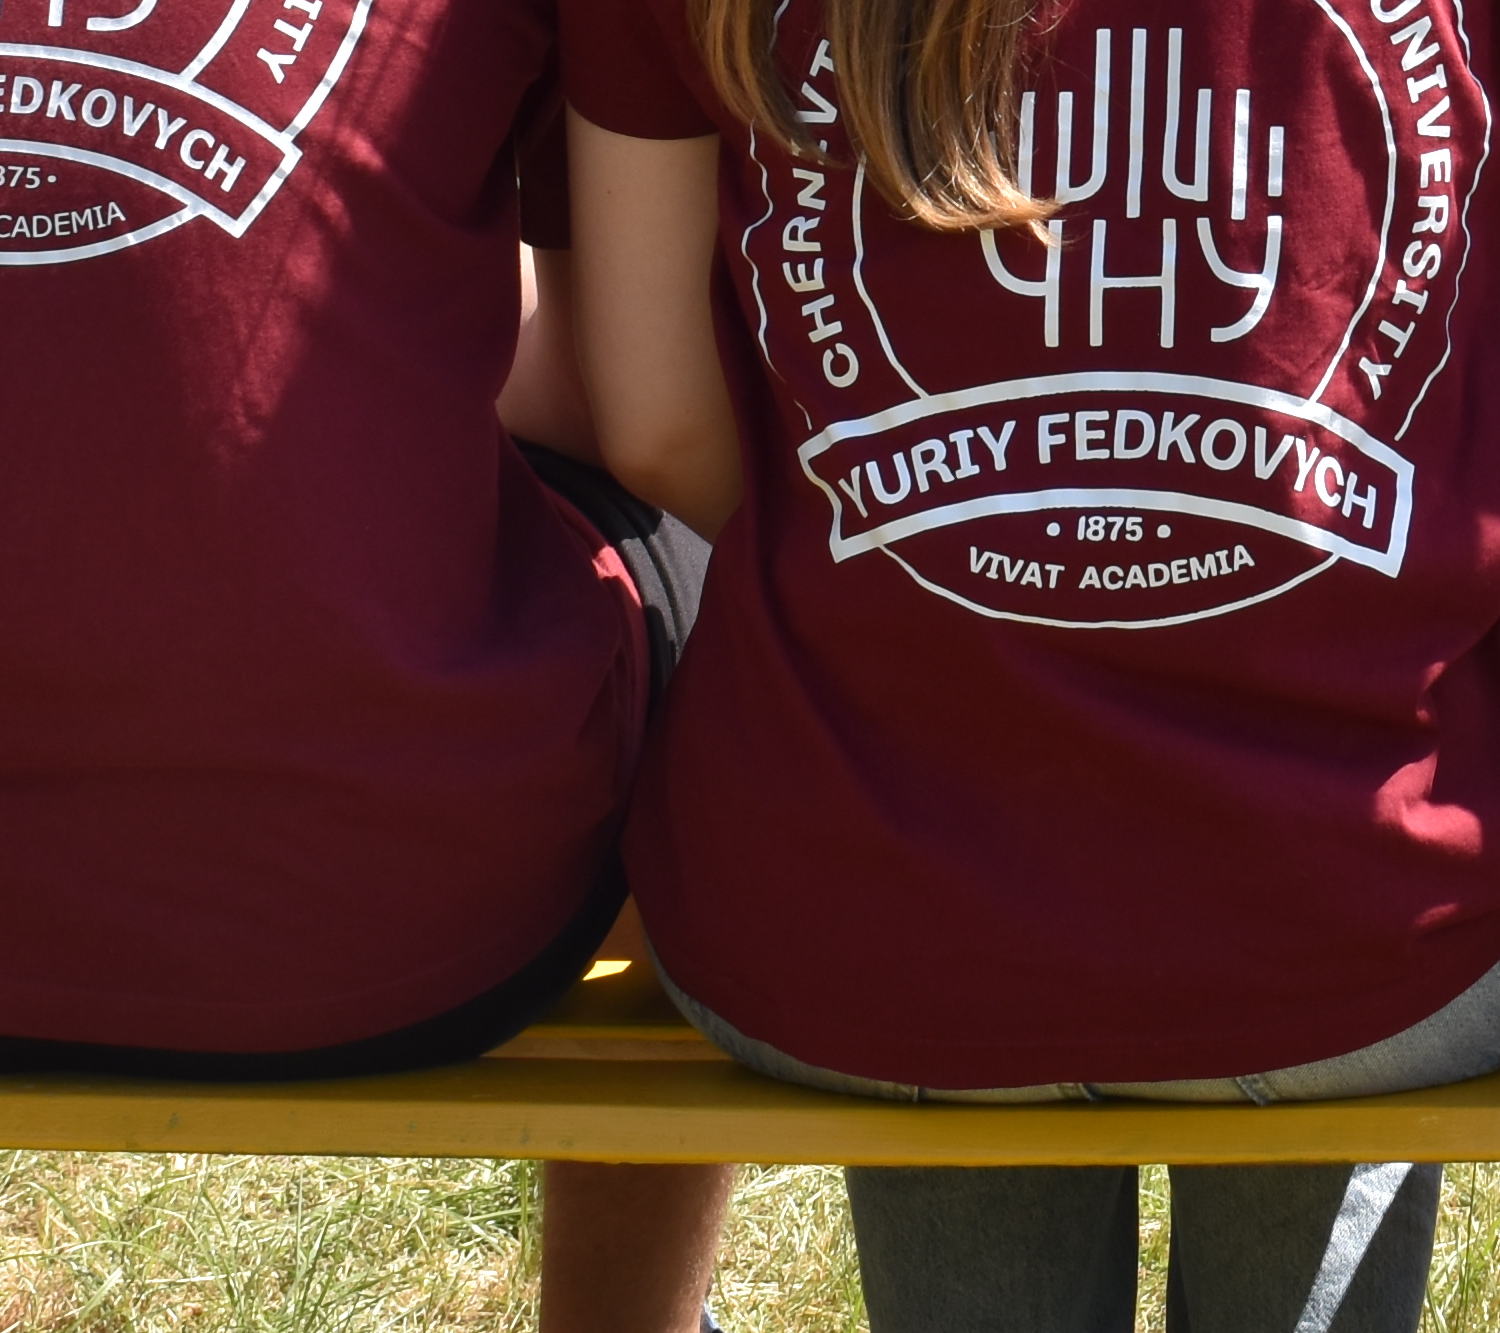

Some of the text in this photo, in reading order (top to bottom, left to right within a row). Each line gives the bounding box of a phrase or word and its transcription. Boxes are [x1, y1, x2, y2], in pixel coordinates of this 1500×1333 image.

[837, 410, 1377, 530] YURIY FEDKOVYCH
[1076, 515, 1143, 542] 1875
[968, 544, 1256, 590] VIVAT ACADEMIA
